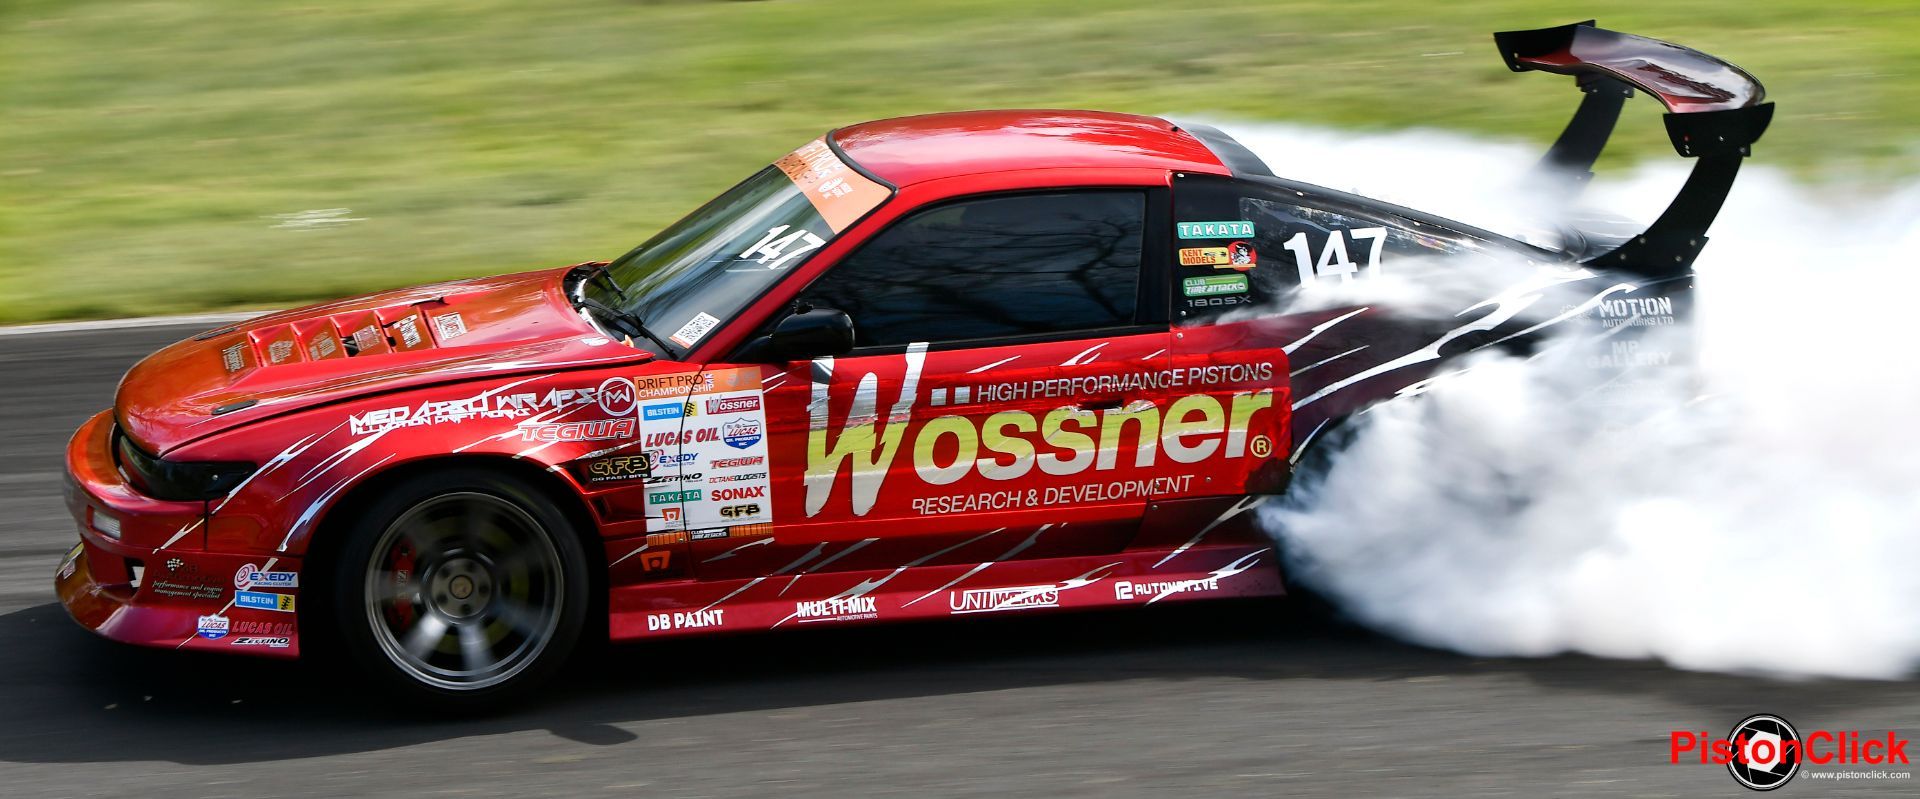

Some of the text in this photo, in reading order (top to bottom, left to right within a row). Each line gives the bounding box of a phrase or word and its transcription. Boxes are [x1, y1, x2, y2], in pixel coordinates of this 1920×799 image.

[1180, 224, 1253, 236] TAKATA
[739, 224, 827, 271] 147
[1182, 249, 1203, 257] KENT
[1183, 256, 1216, 265] MODELS
[1283, 227, 1388, 289] 147
[1187, 296, 1252, 307] 180SX
[1599, 297, 1673, 318] MOTION
[1657, 315, 1674, 326] LTD
[1586, 351, 1672, 369] GALLERY
[638, 374, 704, 390] DRIFT PRO
[977, 362, 1273, 403] HIGH PERFORMANCE PISTONS
[639, 383, 715, 398] CHAMPIONSHIP
[496, 387, 598, 413] WRAPS
[708, 394, 759, 413] Wössner
[435, 411, 475, 424] DRIFT
[647, 406, 680, 417] BILSTEIN
[517, 417, 636, 442] TEGIWA
[728, 426, 758, 437] LUCAS
[645, 427, 720, 448] LUCAS OIL
[589, 455, 649, 476] GFB
[660, 453, 699, 464] EXEDY
[710, 455, 764, 469] TEGIWA
[645, 473, 703, 485] ZESTINO
[651, 491, 701, 503] TAKATA
[711, 485, 765, 502] SONAX
[912, 474, 1195, 515] RESEARCH & DEVELOPMENT
[720, 503, 761, 519] GFB
[250, 573, 297, 581] EXEDY
[152, 580, 190, 590] performance
[190, 583, 204, 591] and
[155, 588, 192, 597] management
[1134, 579, 1219, 596] AUTOMOTIVE
[240, 595, 274, 605] BILSTEIN
[797, 597, 878, 618] MULTI-MIX
[202, 621, 226, 629] LUCAS
[648, 610, 724, 631] DB PAINT
[231, 621, 293, 636] LUCAS OIL
